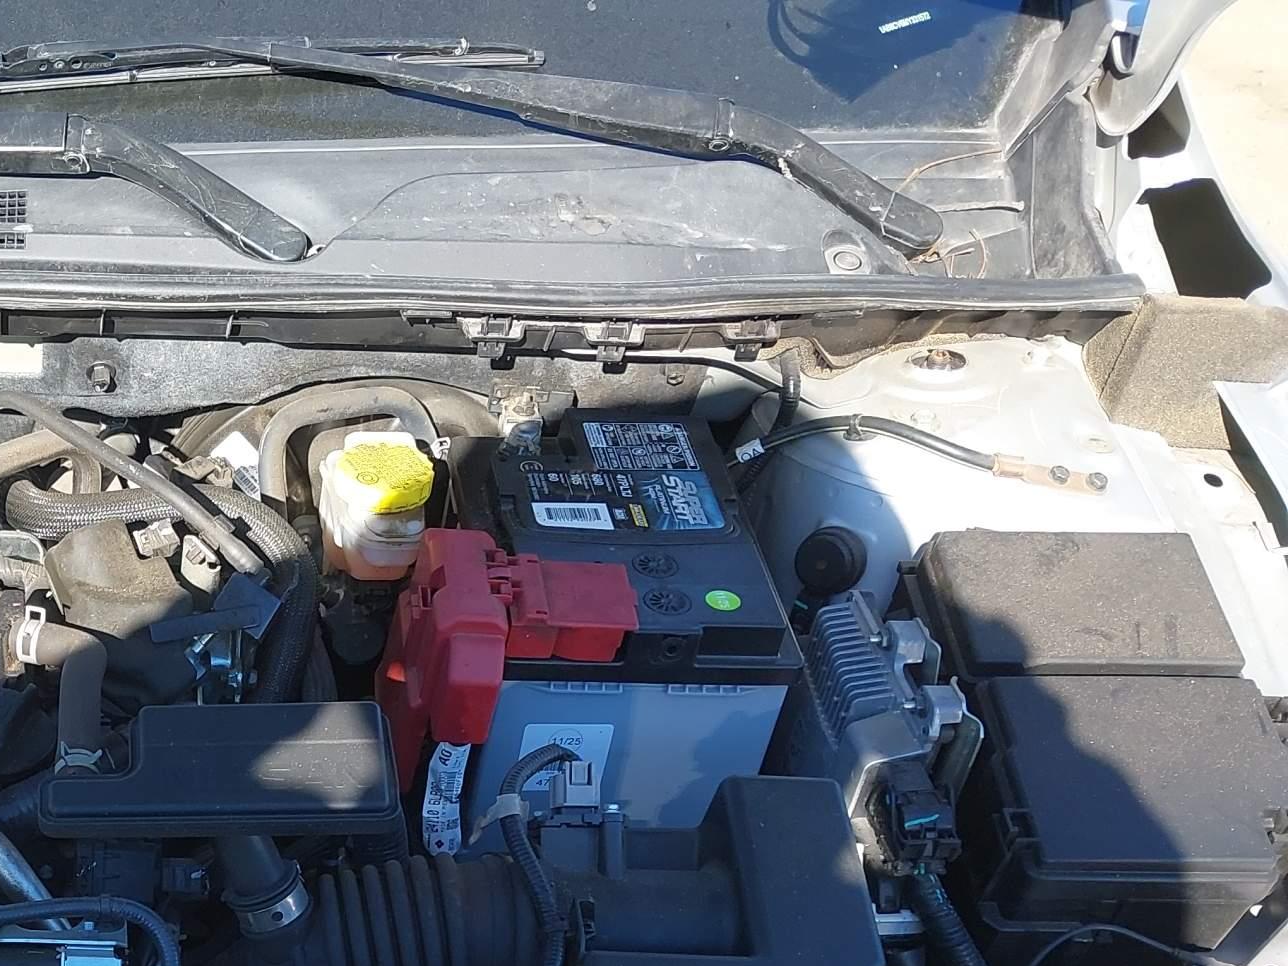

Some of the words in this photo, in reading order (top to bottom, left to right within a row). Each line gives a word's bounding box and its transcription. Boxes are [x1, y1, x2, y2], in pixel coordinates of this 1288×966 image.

[570, 473, 583, 485] 105
[654, 483, 671, 515] PLATINUM
[661, 474, 694, 524] START
[682, 480, 708, 526] SUPER
[551, 737, 581, 746] 11/25
